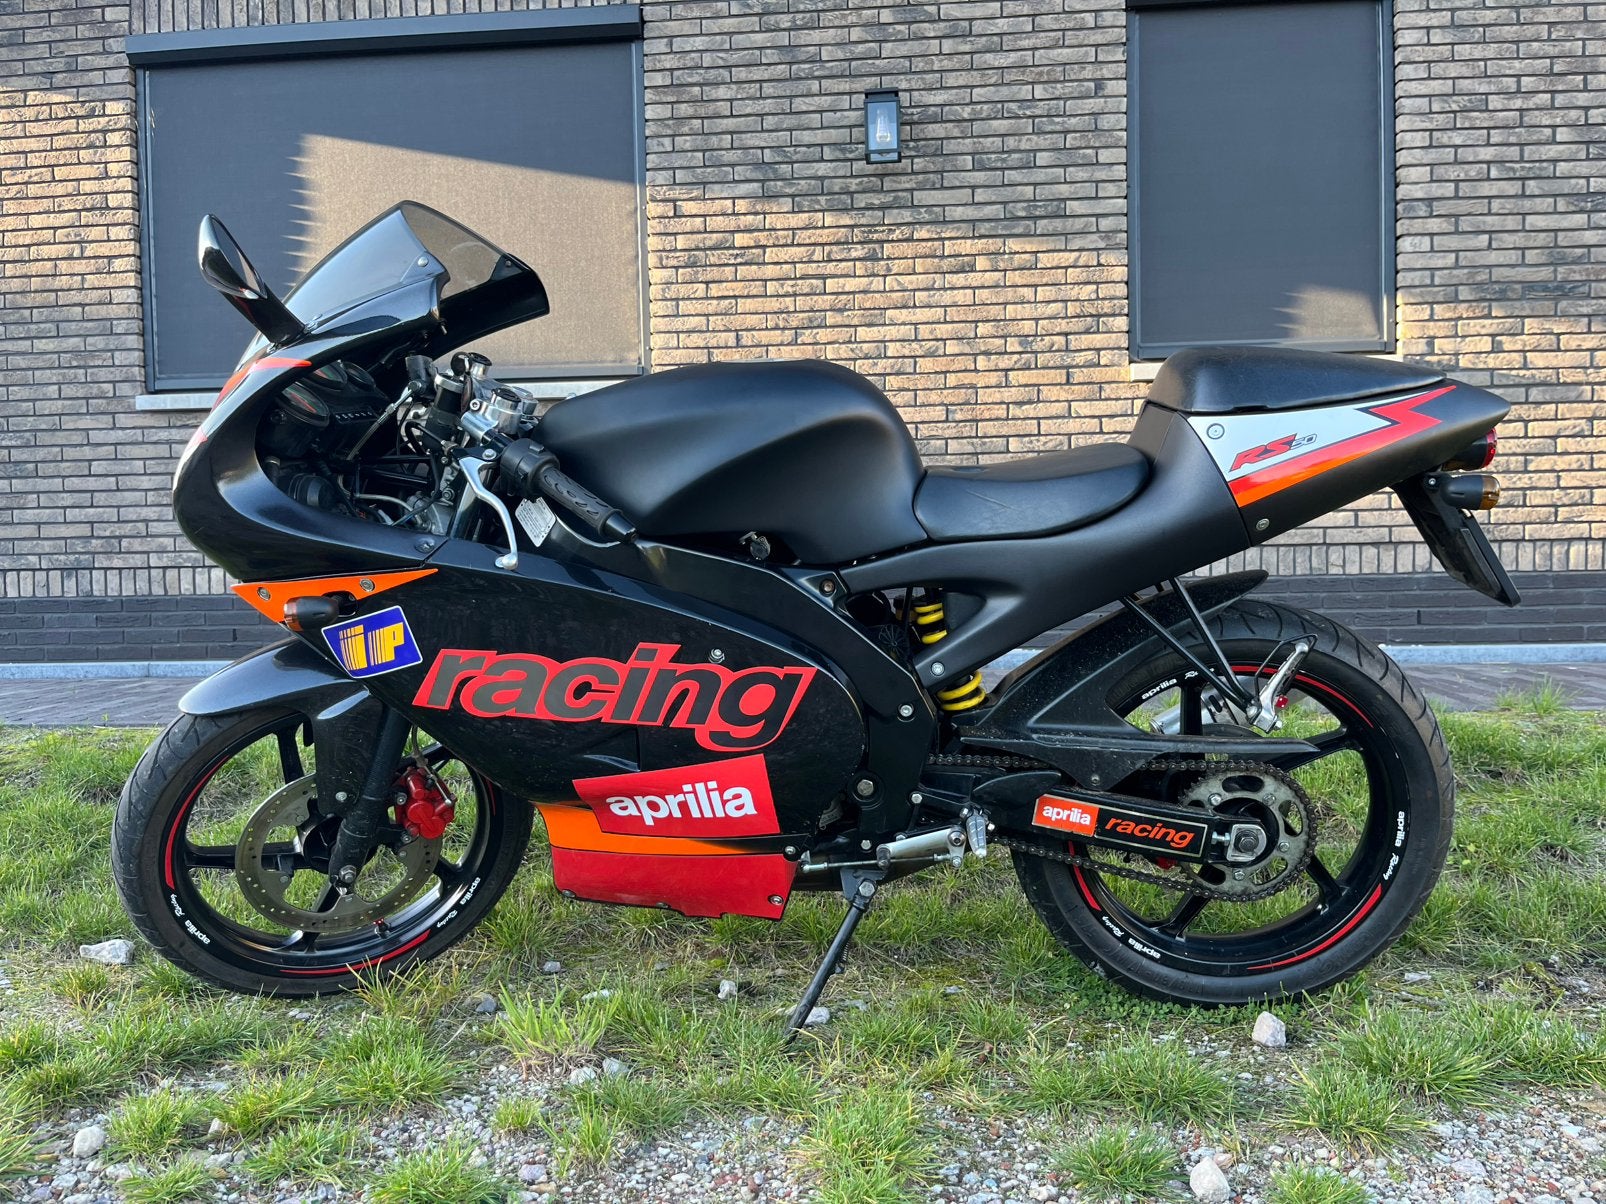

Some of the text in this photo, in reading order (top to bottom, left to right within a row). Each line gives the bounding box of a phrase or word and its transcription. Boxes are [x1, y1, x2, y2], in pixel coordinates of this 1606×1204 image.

[422, 645, 809, 749] racing
[1141, 678, 1177, 700] aprilia
[605, 781, 757, 826] aprilia
[1042, 805, 1195, 849] aprilia racing
[1395, 810, 1405, 847] aprilia
